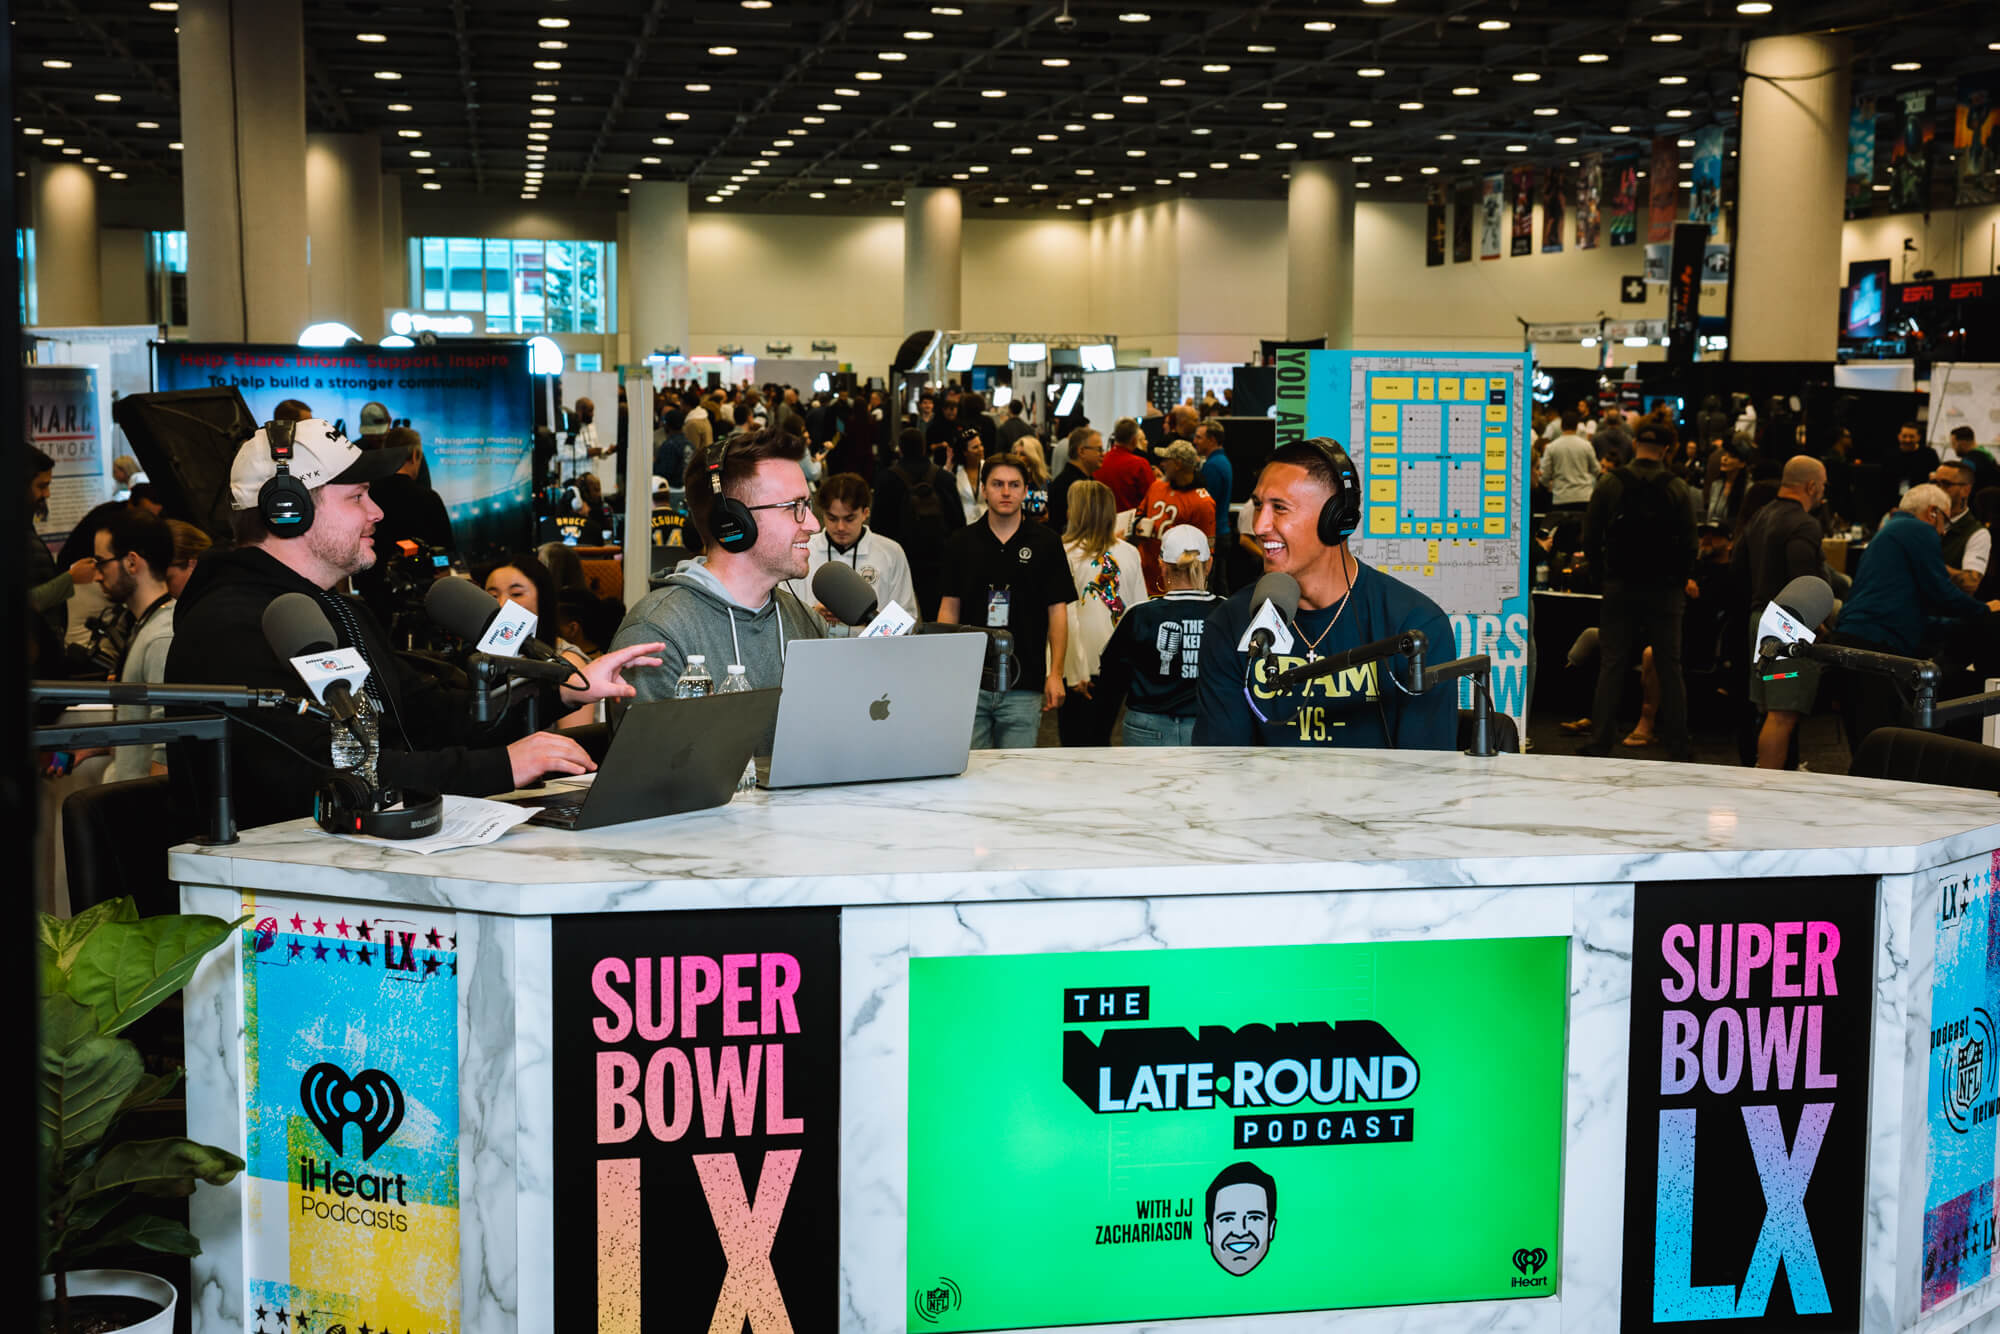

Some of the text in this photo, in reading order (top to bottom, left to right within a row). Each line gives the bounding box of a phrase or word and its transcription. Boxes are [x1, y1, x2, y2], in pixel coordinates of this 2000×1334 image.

[180, 352, 509, 370] Help. Share. Inform. Support. Inspire
[208, 375, 227, 389] To
[232, 375, 265, 390] help
[270, 375, 309, 389] build
[314, 379, 324, 389] a
[331, 377, 393, 391] stronger
[1277, 352, 1306, 447] YOU AR
[1153, 500, 1178, 539] 22
[1182, 620, 1204, 634] THE
[1447, 612, 1528, 660] ORS
[1181, 664, 1199, 678] SH
[1182, 650, 1199, 664] WI
[1942, 882, 1958, 922] LX
[384, 929, 418, 972] LX
[1660, 920, 1841, 1003] SUPER
[591, 952, 801, 1043] SUPER
[1074, 992, 1141, 1017] THE
[1660, 1005, 1838, 1096] BOWL
[1930, 1016, 1969, 1055] podcast
[596, 1043, 805, 1144] BOWL
[1958, 1065, 1980, 1101] NFL
[1972, 1096, 2000, 1125] netwo
[1243, 1115, 1405, 1144] PODCAST
[301, 1155, 407, 1207] iHeart
[301, 1195, 408, 1232] Podcasts
[1136, 1198, 1193, 1219] WITH JJ
[1653, 1102, 1836, 1323] LX
[1095, 1221, 1193, 1245] ZACHARIASON
[1511, 1276, 1547, 1288] iHeart
